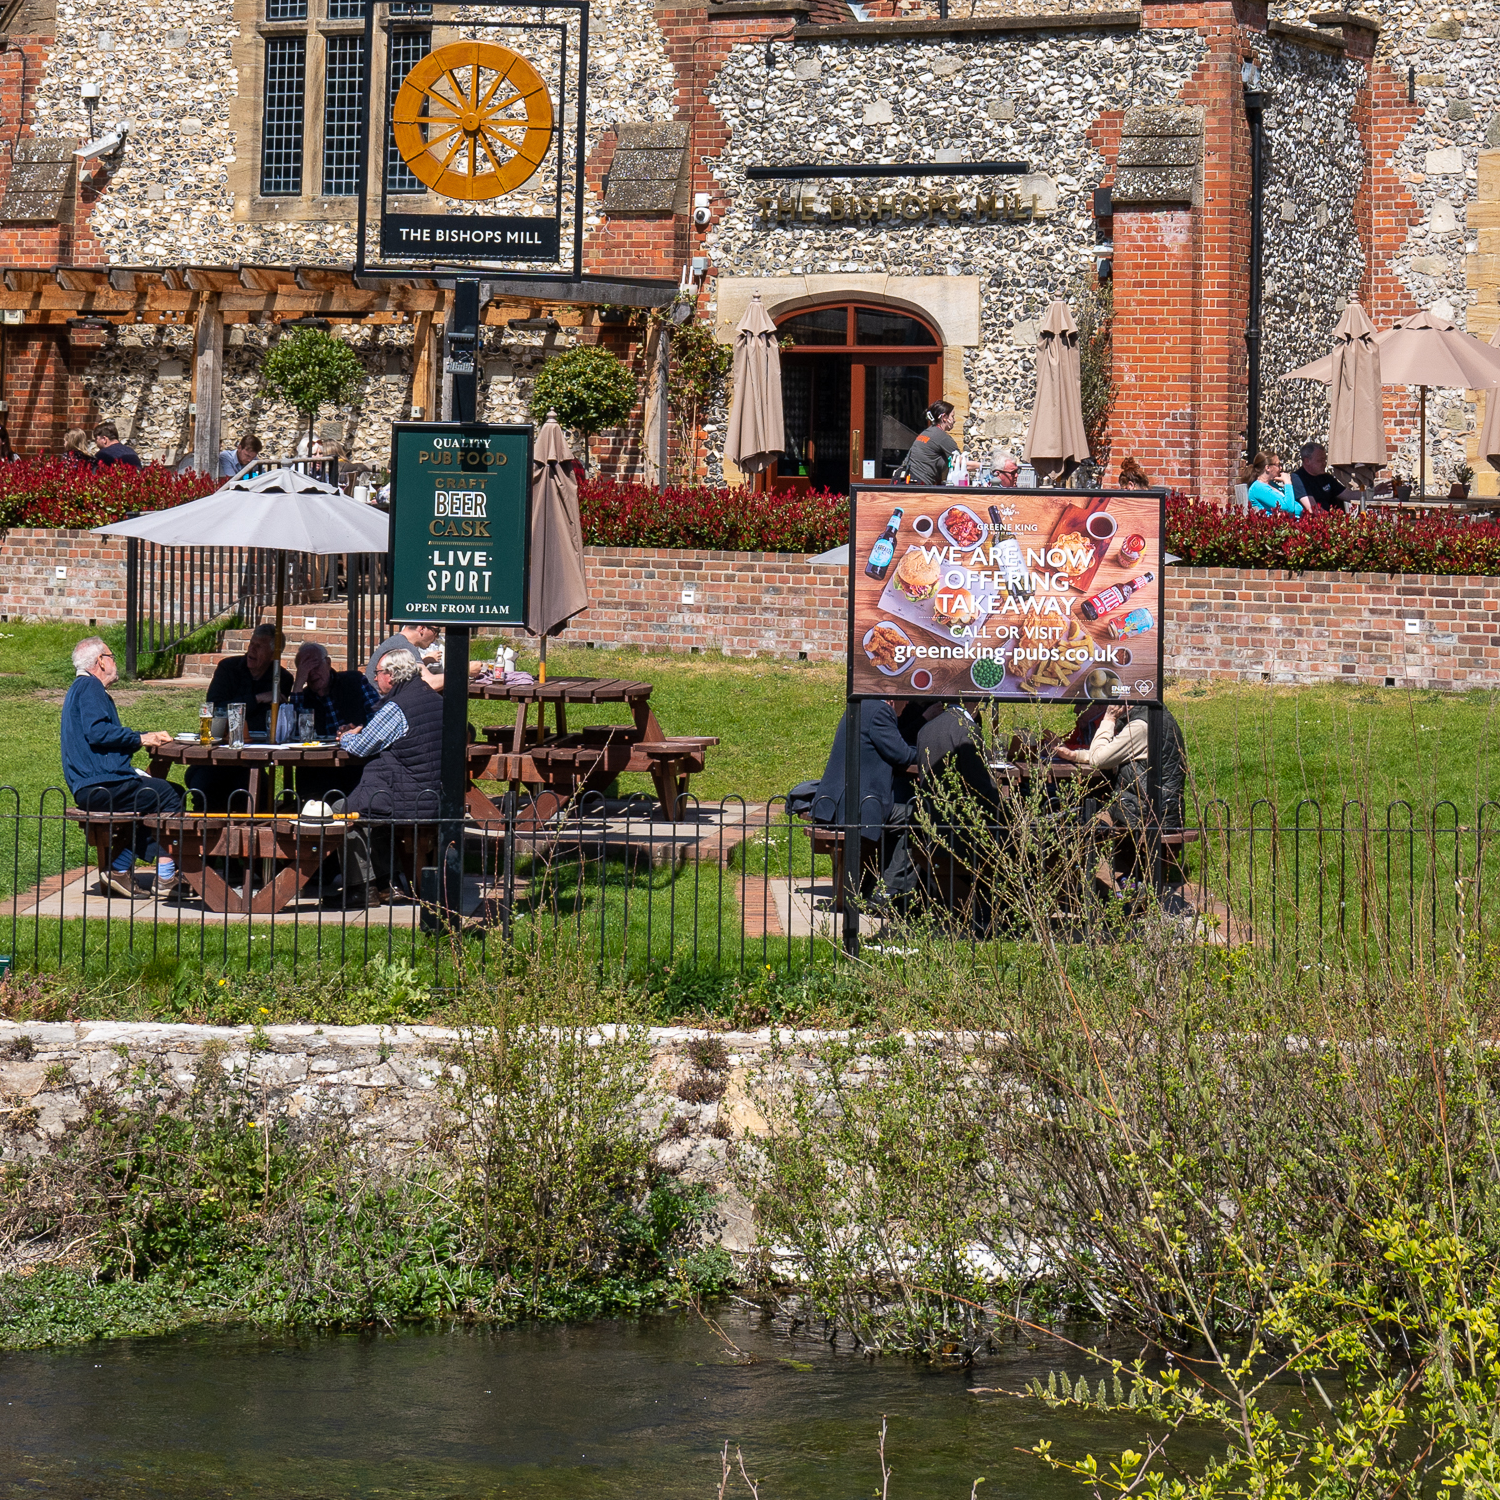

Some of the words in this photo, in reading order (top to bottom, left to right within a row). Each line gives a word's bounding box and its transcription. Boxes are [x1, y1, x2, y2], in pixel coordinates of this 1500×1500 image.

[755, 197, 816, 221] THE
[831, 194, 961, 221] BISHOPS
[976, 193, 1047, 219] MILL
[399, 228, 431, 241] THE
[436, 229, 502, 243] BISHOPS
[506, 231, 542, 244] MILL
[433, 438, 491, 449] QUALITY
[419, 451, 452, 465] PUB
[457, 451, 508, 466] FOOD
[435, 478, 488, 489] CRAFT
[434, 490, 487, 518] BEER
[429, 519, 492, 537] CASK
[976, 523, 1012, 531] GREENE
[920, 545, 962, 566] WE
[970, 546, 1018, 567] ARE
[1026, 547, 1094, 568] NOW
[427, 569, 492, 592] SPORT
[944, 570, 1069, 592] OFFERING
[405, 603, 437, 612] OPEN
[441, 604, 475, 614] FROM
[479, 605, 509, 614] 11AM
[937, 593, 1077, 616] TAKEAWAY
[949, 624, 991, 639] CALL
[995, 625, 1019, 639] OR
[1024, 625, 1064, 640] VISIT
[893, 641, 1119, 665] greeneking-pubs.co.uk
